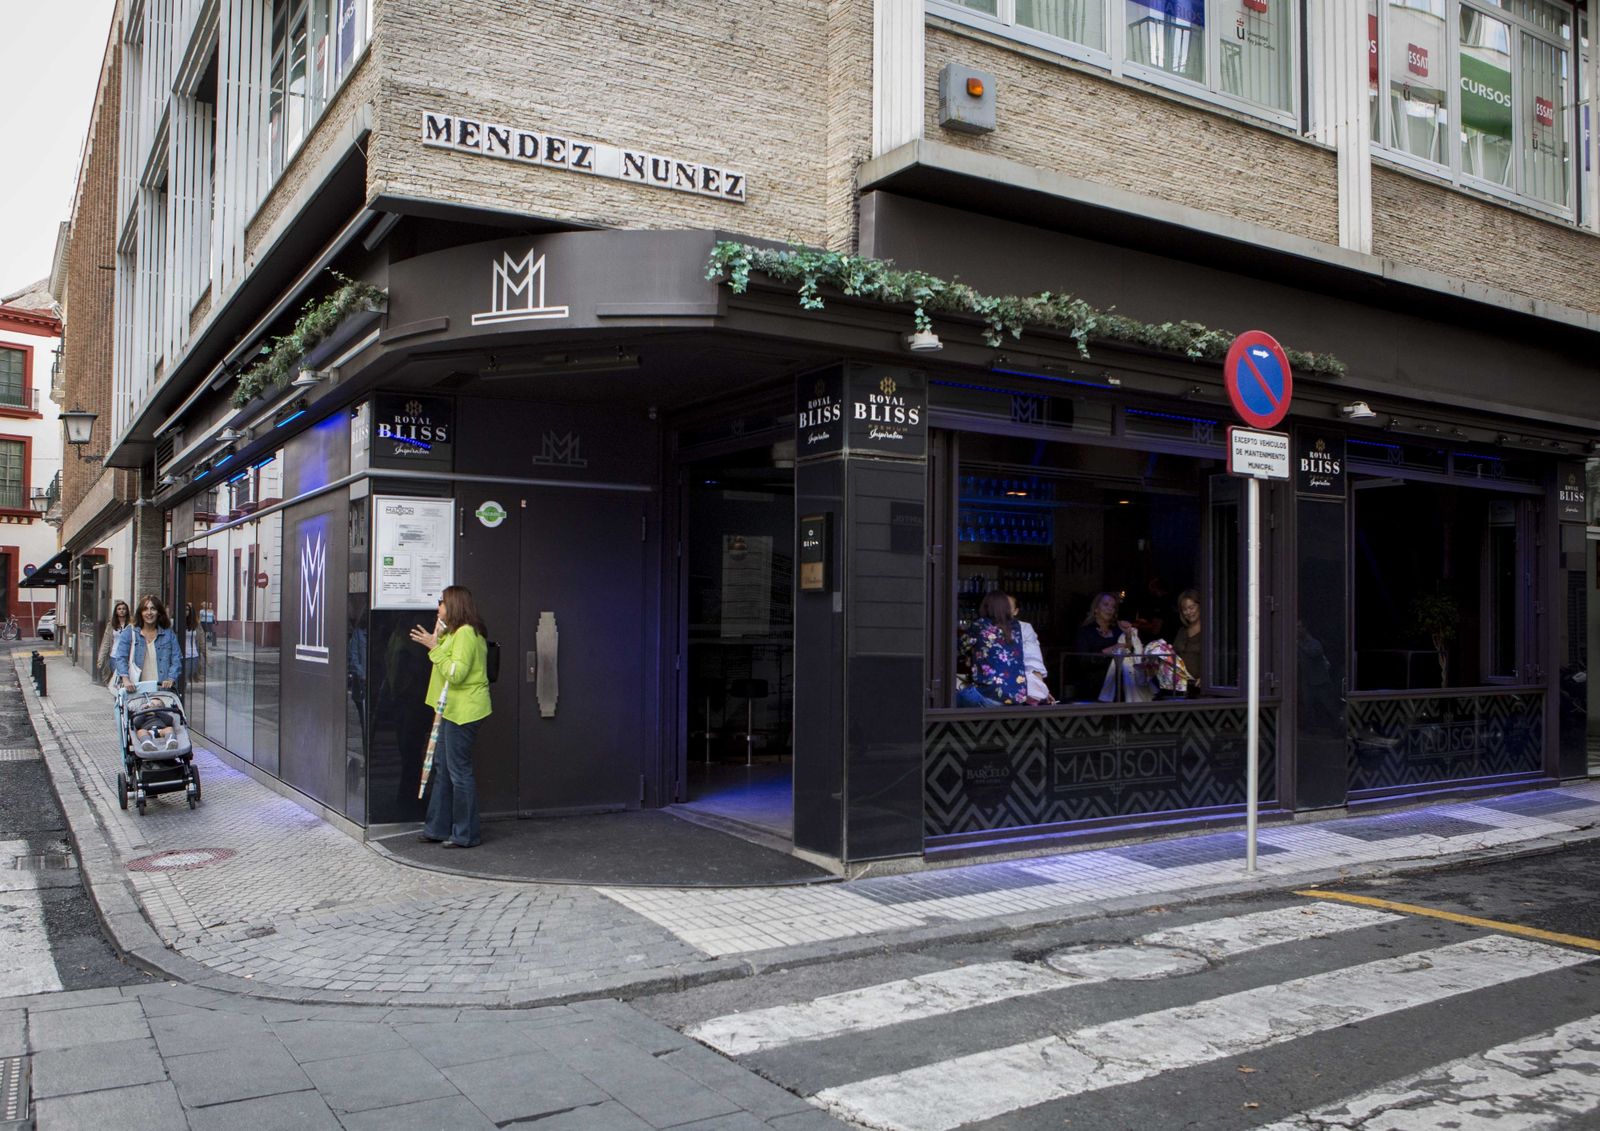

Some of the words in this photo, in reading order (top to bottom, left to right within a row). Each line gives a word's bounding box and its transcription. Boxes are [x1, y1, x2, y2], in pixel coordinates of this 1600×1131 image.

[1460, 77, 1512, 107] CURSOS
[426, 115, 593, 170] MENDEZ
[807, 395, 832, 410] ROYAL
[869, 393, 906, 407] ROYAL
[394, 415, 432, 425] ROYAL
[799, 403, 841, 429] BLISS
[854, 402, 920, 425] BLISS
[378, 423, 447, 442] BLISS
[1234, 436, 1258, 446] EXCEPTO
[1259, 440, 1287, 450] VEHICULOS
[1235, 448, 1243, 456] DE
[1244, 449, 1286, 461] MANTENIMIENTO
[1248, 461, 1275, 472] MUNICIPAL
[1300, 458, 1340, 475] BLISS
[1559, 490, 1585, 503] BLISS
[1407, 725, 1488, 754] MADISON
[1053, 748, 1177, 785] MADISON
